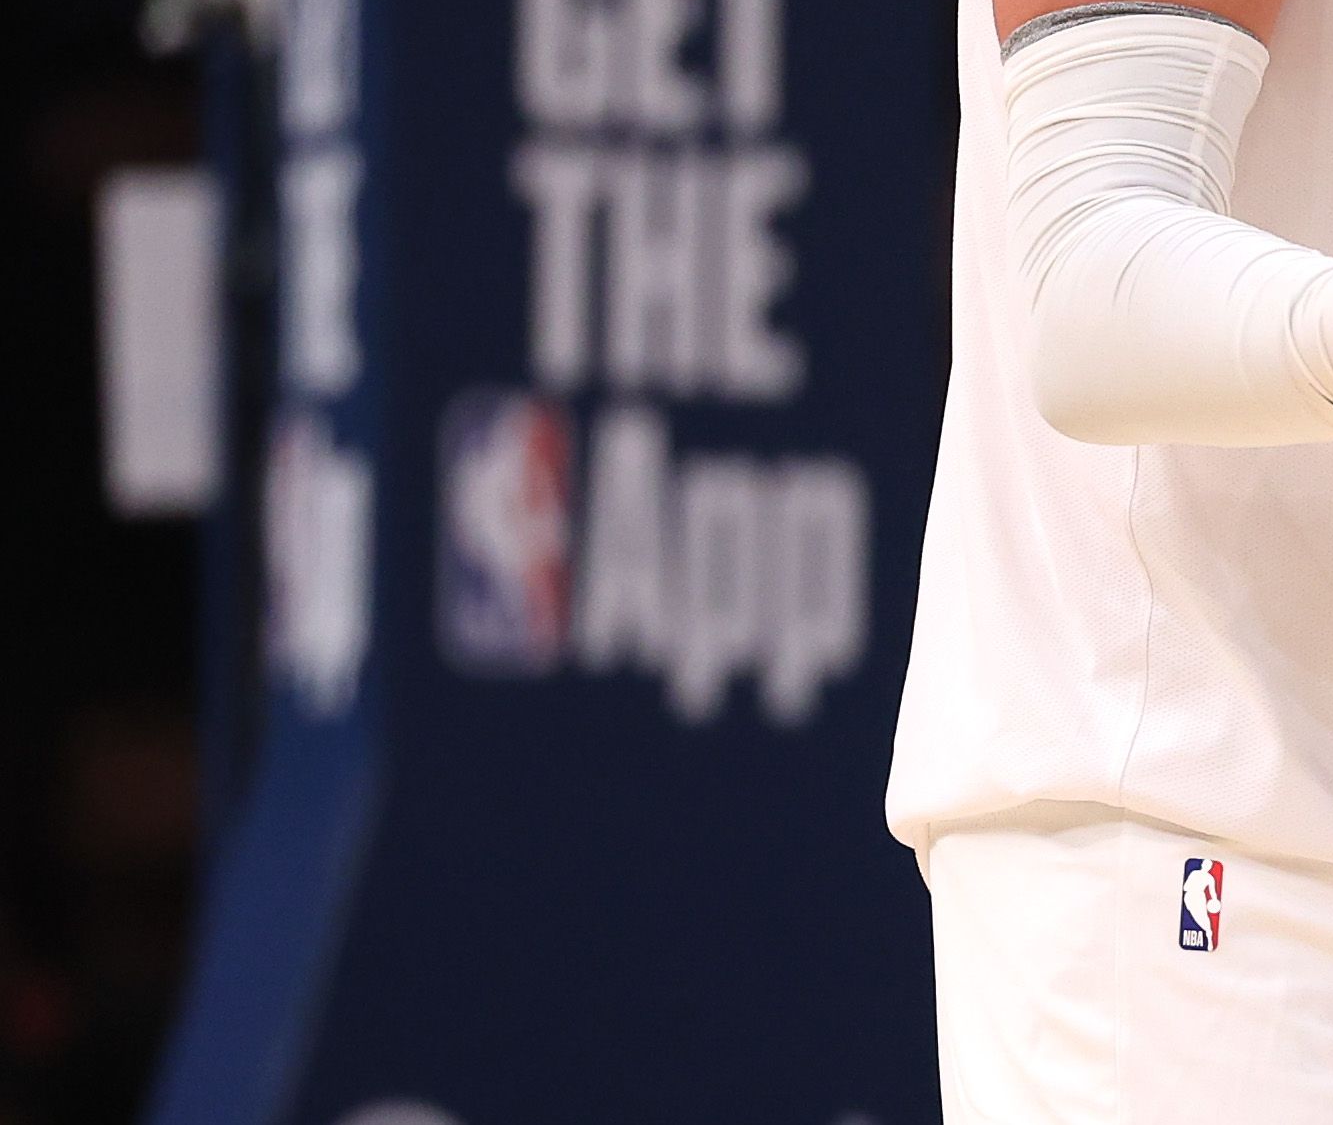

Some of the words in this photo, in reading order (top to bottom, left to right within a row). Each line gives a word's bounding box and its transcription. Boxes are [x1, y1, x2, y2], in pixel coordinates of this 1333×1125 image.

[508, 145, 808, 399] THE
[578, 403, 870, 723] App
[1183, 929, 1204, 947] NBA
